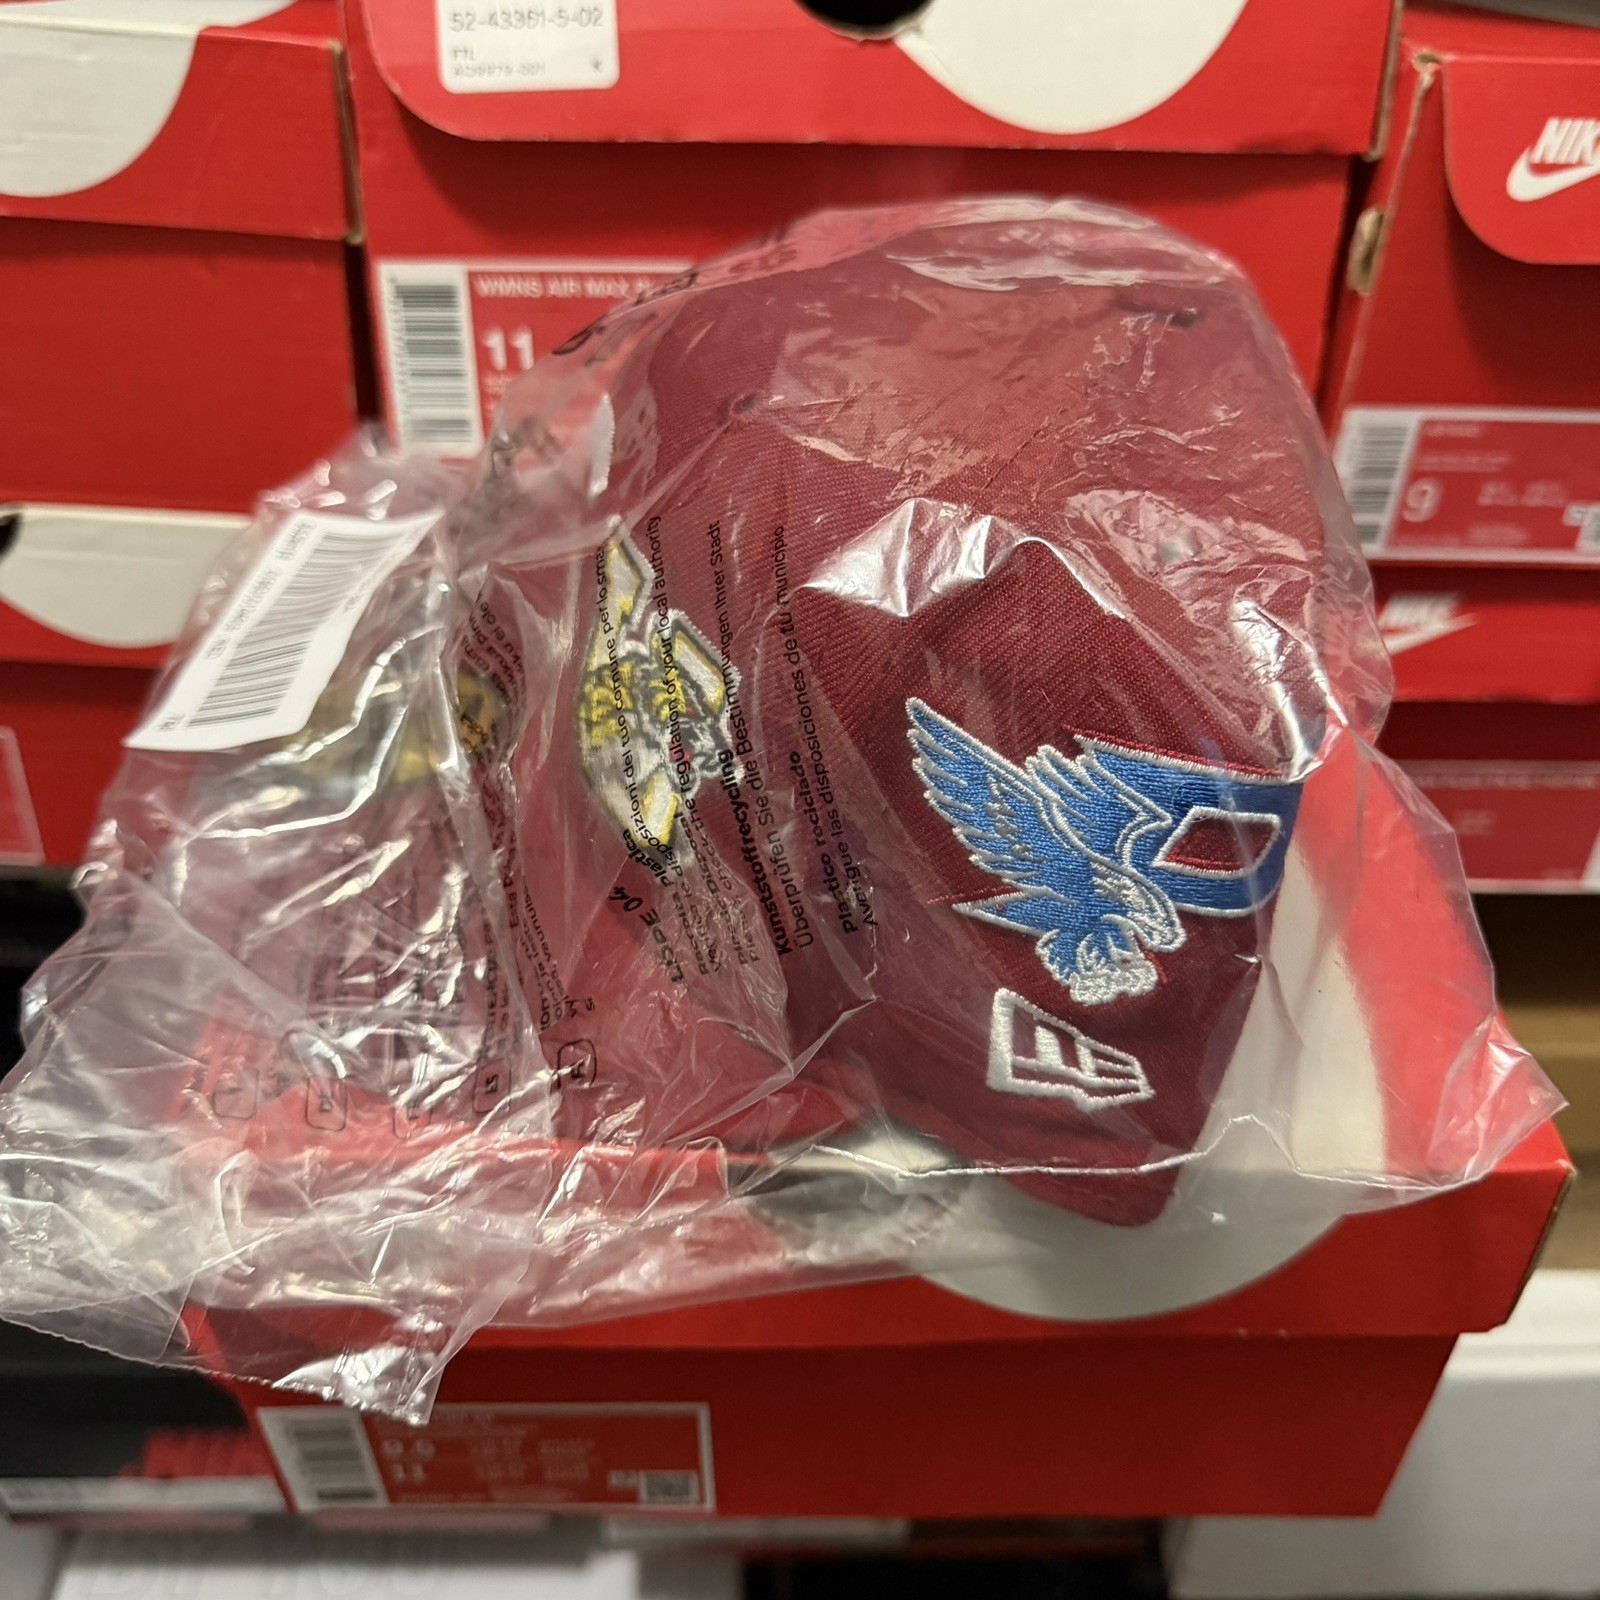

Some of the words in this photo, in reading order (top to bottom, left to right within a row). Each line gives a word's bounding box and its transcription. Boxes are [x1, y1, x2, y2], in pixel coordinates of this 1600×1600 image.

[1529, 117, 1600, 164] NIK
[483, 328, 534, 370] 11
[1402, 478, 1443, 523] 9
[645, 517, 667, 589] authority
[707, 520, 723, 567] Stadt
[770, 526, 790, 606] municipio
[714, 570, 728, 610] Ihrer
[598, 606, 615, 635] per
[653, 593, 672, 635] local
[779, 612, 795, 635] tu
[661, 637, 679, 679] your
[783, 638, 801, 666] de
[606, 638, 624, 711] comune
[662, 679, 676, 695] of
[717, 610, 753, 756] Bestimmungen
[617, 714, 631, 748] tuo
[667, 698, 693, 793] regulation
[792, 669, 834, 805] disposiciones
[622, 749, 635, 779] del
[743, 759, 764, 791] die
[685, 798, 704, 832] the
[756, 795, 774, 826] Sie
[789, 751, 827, 847] reciclado
[625, 781, 683, 878] disposizioni
[827, 809, 842, 837] las
[622, 829, 675, 887] Plastica
[717, 749, 793, 957] Kunststoffrecycling
[608, 886, 644, 912] 04
[766, 831, 814, 948] Überprüfen
